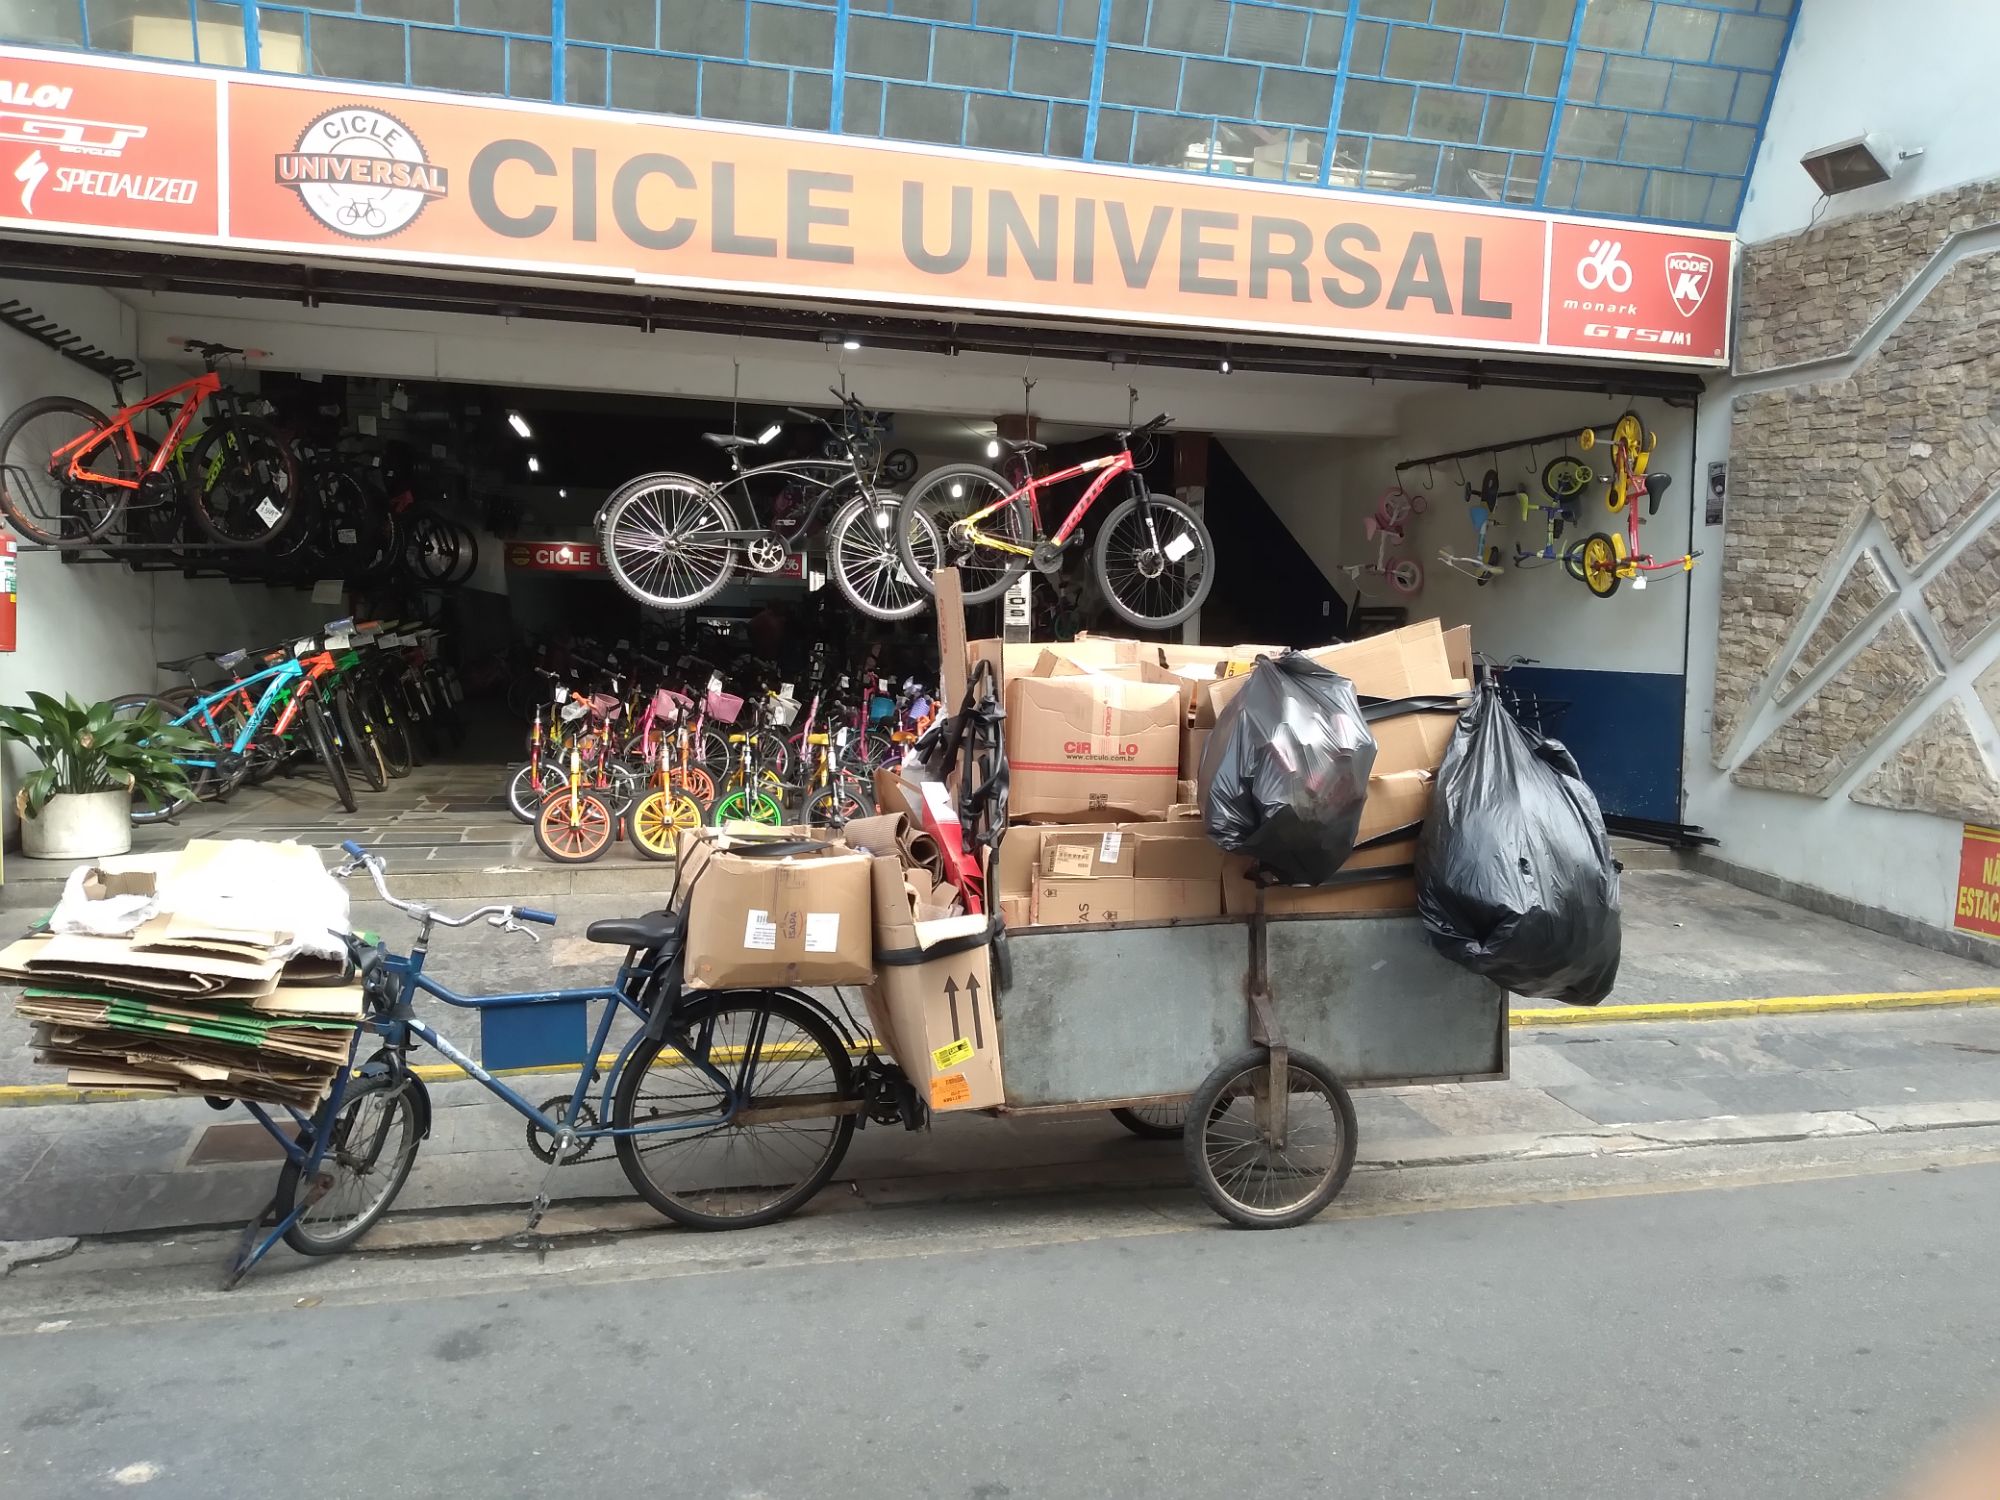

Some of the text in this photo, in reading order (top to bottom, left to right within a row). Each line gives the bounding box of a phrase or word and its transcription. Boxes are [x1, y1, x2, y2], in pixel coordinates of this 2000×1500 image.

[322, 115, 402, 147] CICLE
[279, 156, 446, 193] UNIVERSAL
[52, 167, 198, 204] SPECIALIZED
[468, 139, 1513, 320] CICLE UNIVERSAL
[1669, 257, 1709, 273] KODE
[1674, 273, 1702, 301] K
[1563, 298, 1637, 316] monark
[536, 549, 591, 565] CICLE
[1063, 741, 1139, 756] CiRLO
[1066, 754, 1135, 762] www.circulo.com.br
[1079, 903, 1090, 922] AS
